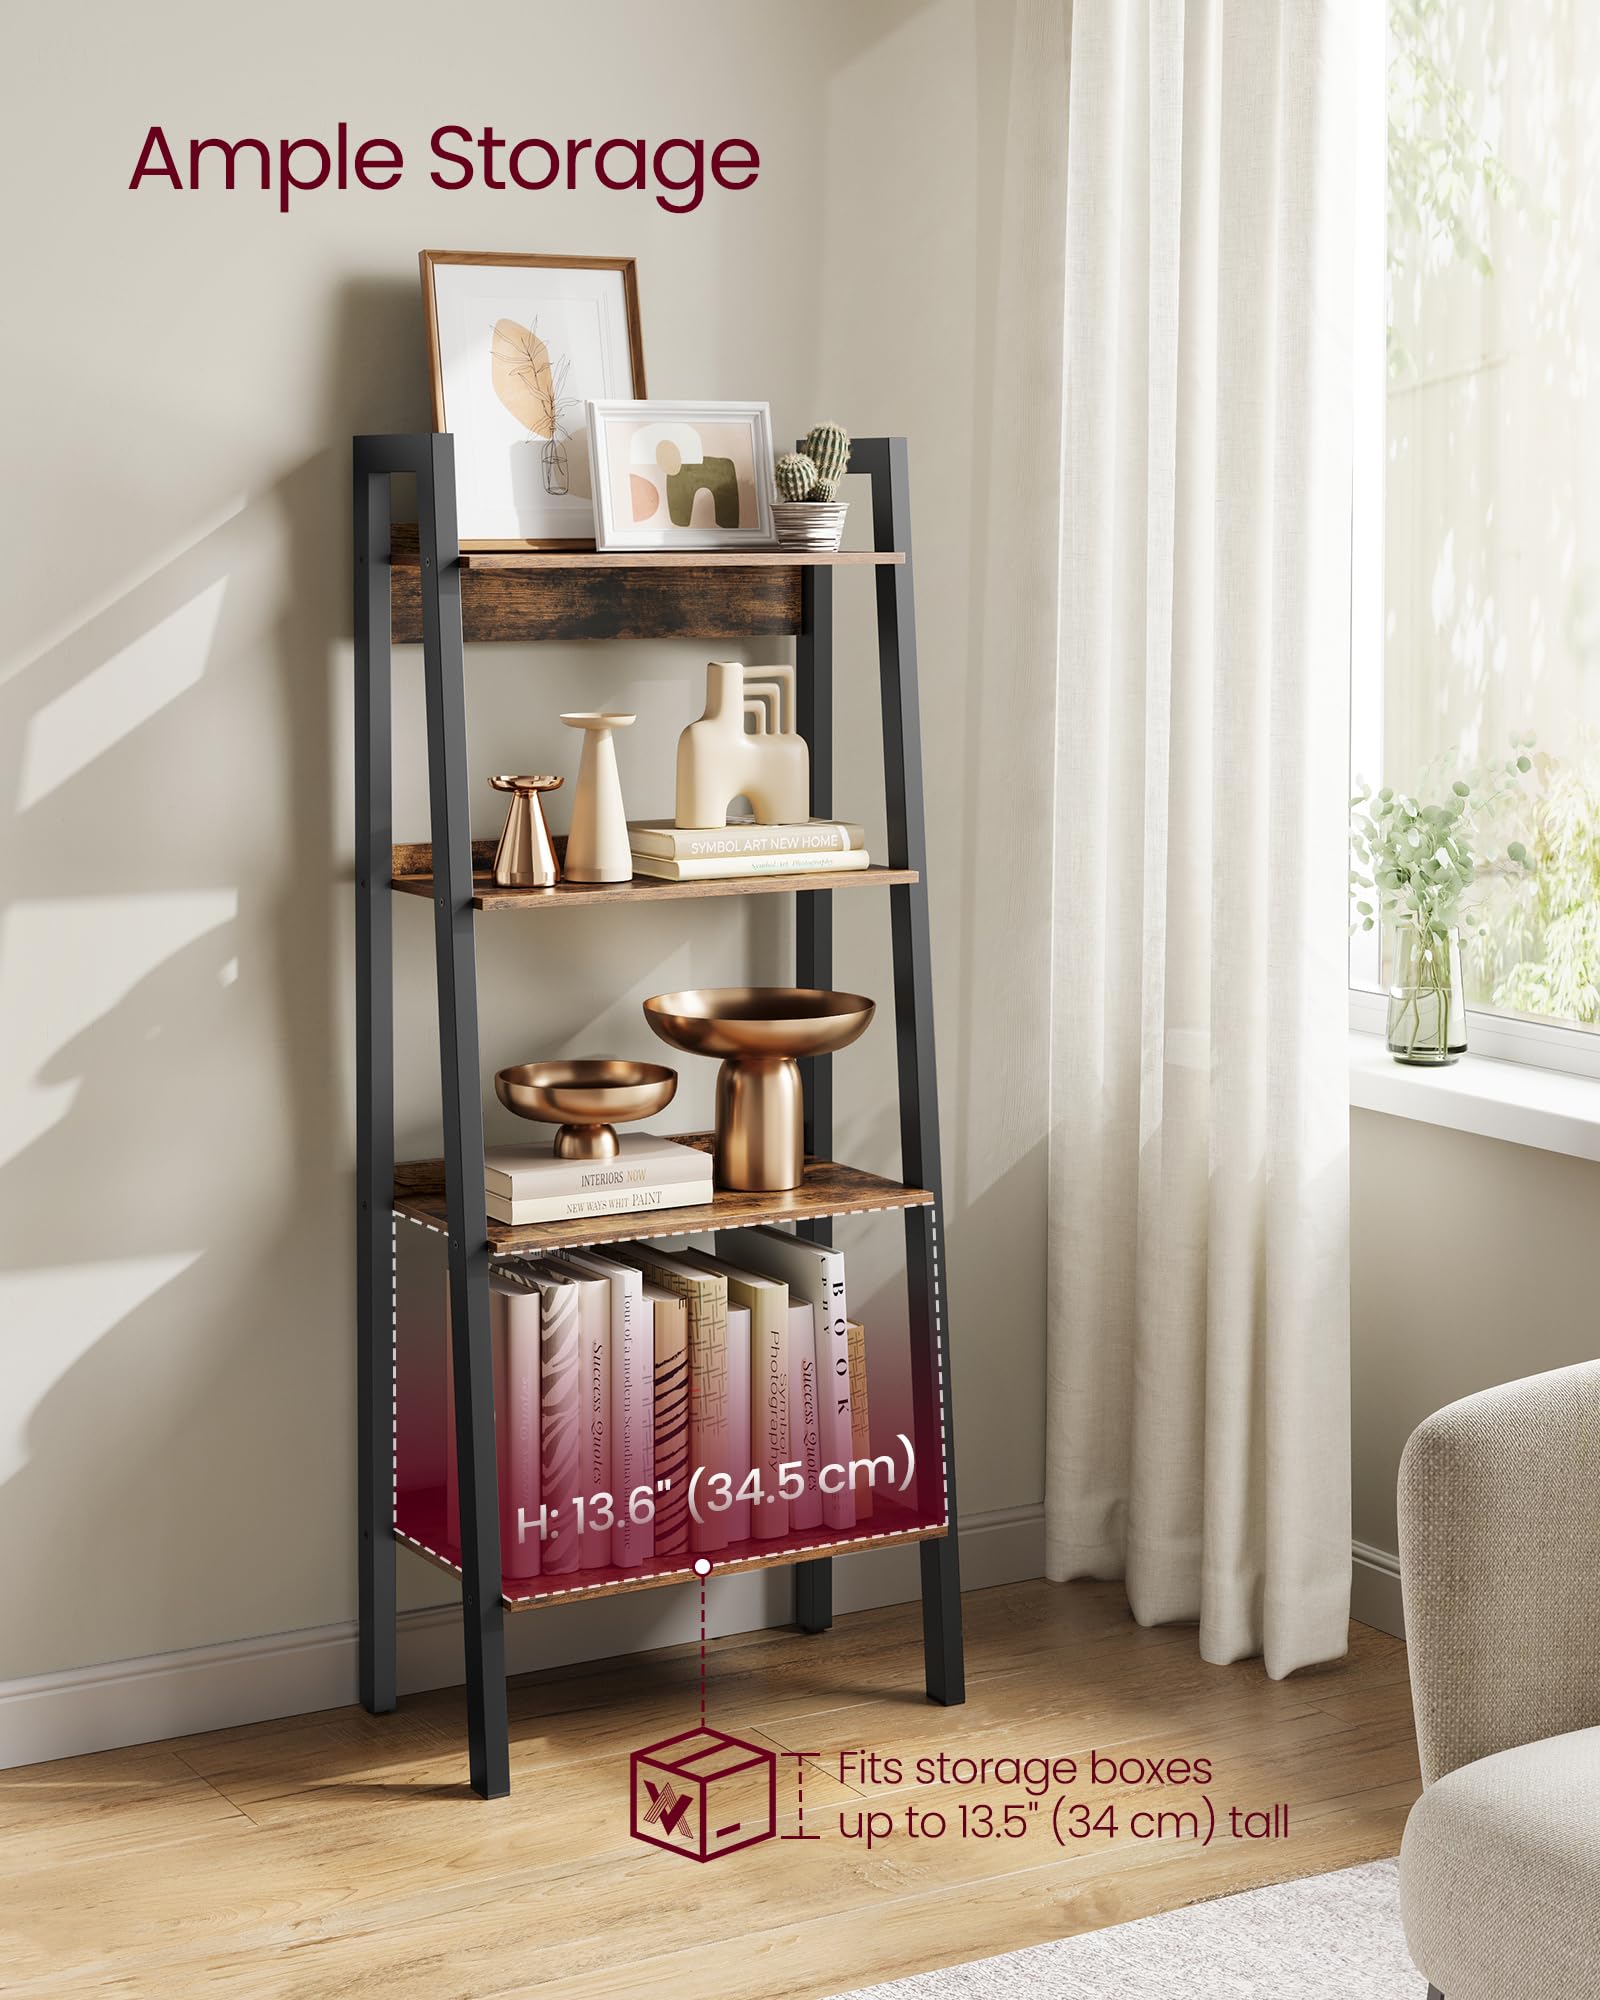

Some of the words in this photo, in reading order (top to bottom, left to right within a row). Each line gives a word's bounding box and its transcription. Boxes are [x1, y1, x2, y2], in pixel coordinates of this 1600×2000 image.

[690, 840, 742, 855] SYMBOL
[743, 838, 769, 851] ART
[770, 836, 799, 850] NEW
[801, 834, 839, 848] HOME
[566, 1201, 585, 1215] NEW
[586, 1199, 607, 1212] WAYS
[608, 1197, 629, 1209] WHIT
[631, 1191, 663, 1207] PAINT
[580, 1171, 624, 1188] INTERIORS
[627, 1169, 647, 1183] NOW
[623, 1292, 633, 1326] Tour
[623, 1328, 633, 1344] of
[592, 1339, 604, 1413] Success
[624, 1346, 632, 1354] a
[832, 1281, 850, 1416] BOOK
[623, 1358, 633, 1412] modern
[767, 1330, 780, 1472] Photography
[802, 1359, 814, 1425] Success
[779, 1372, 788, 1456] Symbol
[594, 1418, 606, 1486] Quotes
[803, 1431, 818, 1491] Quotes
